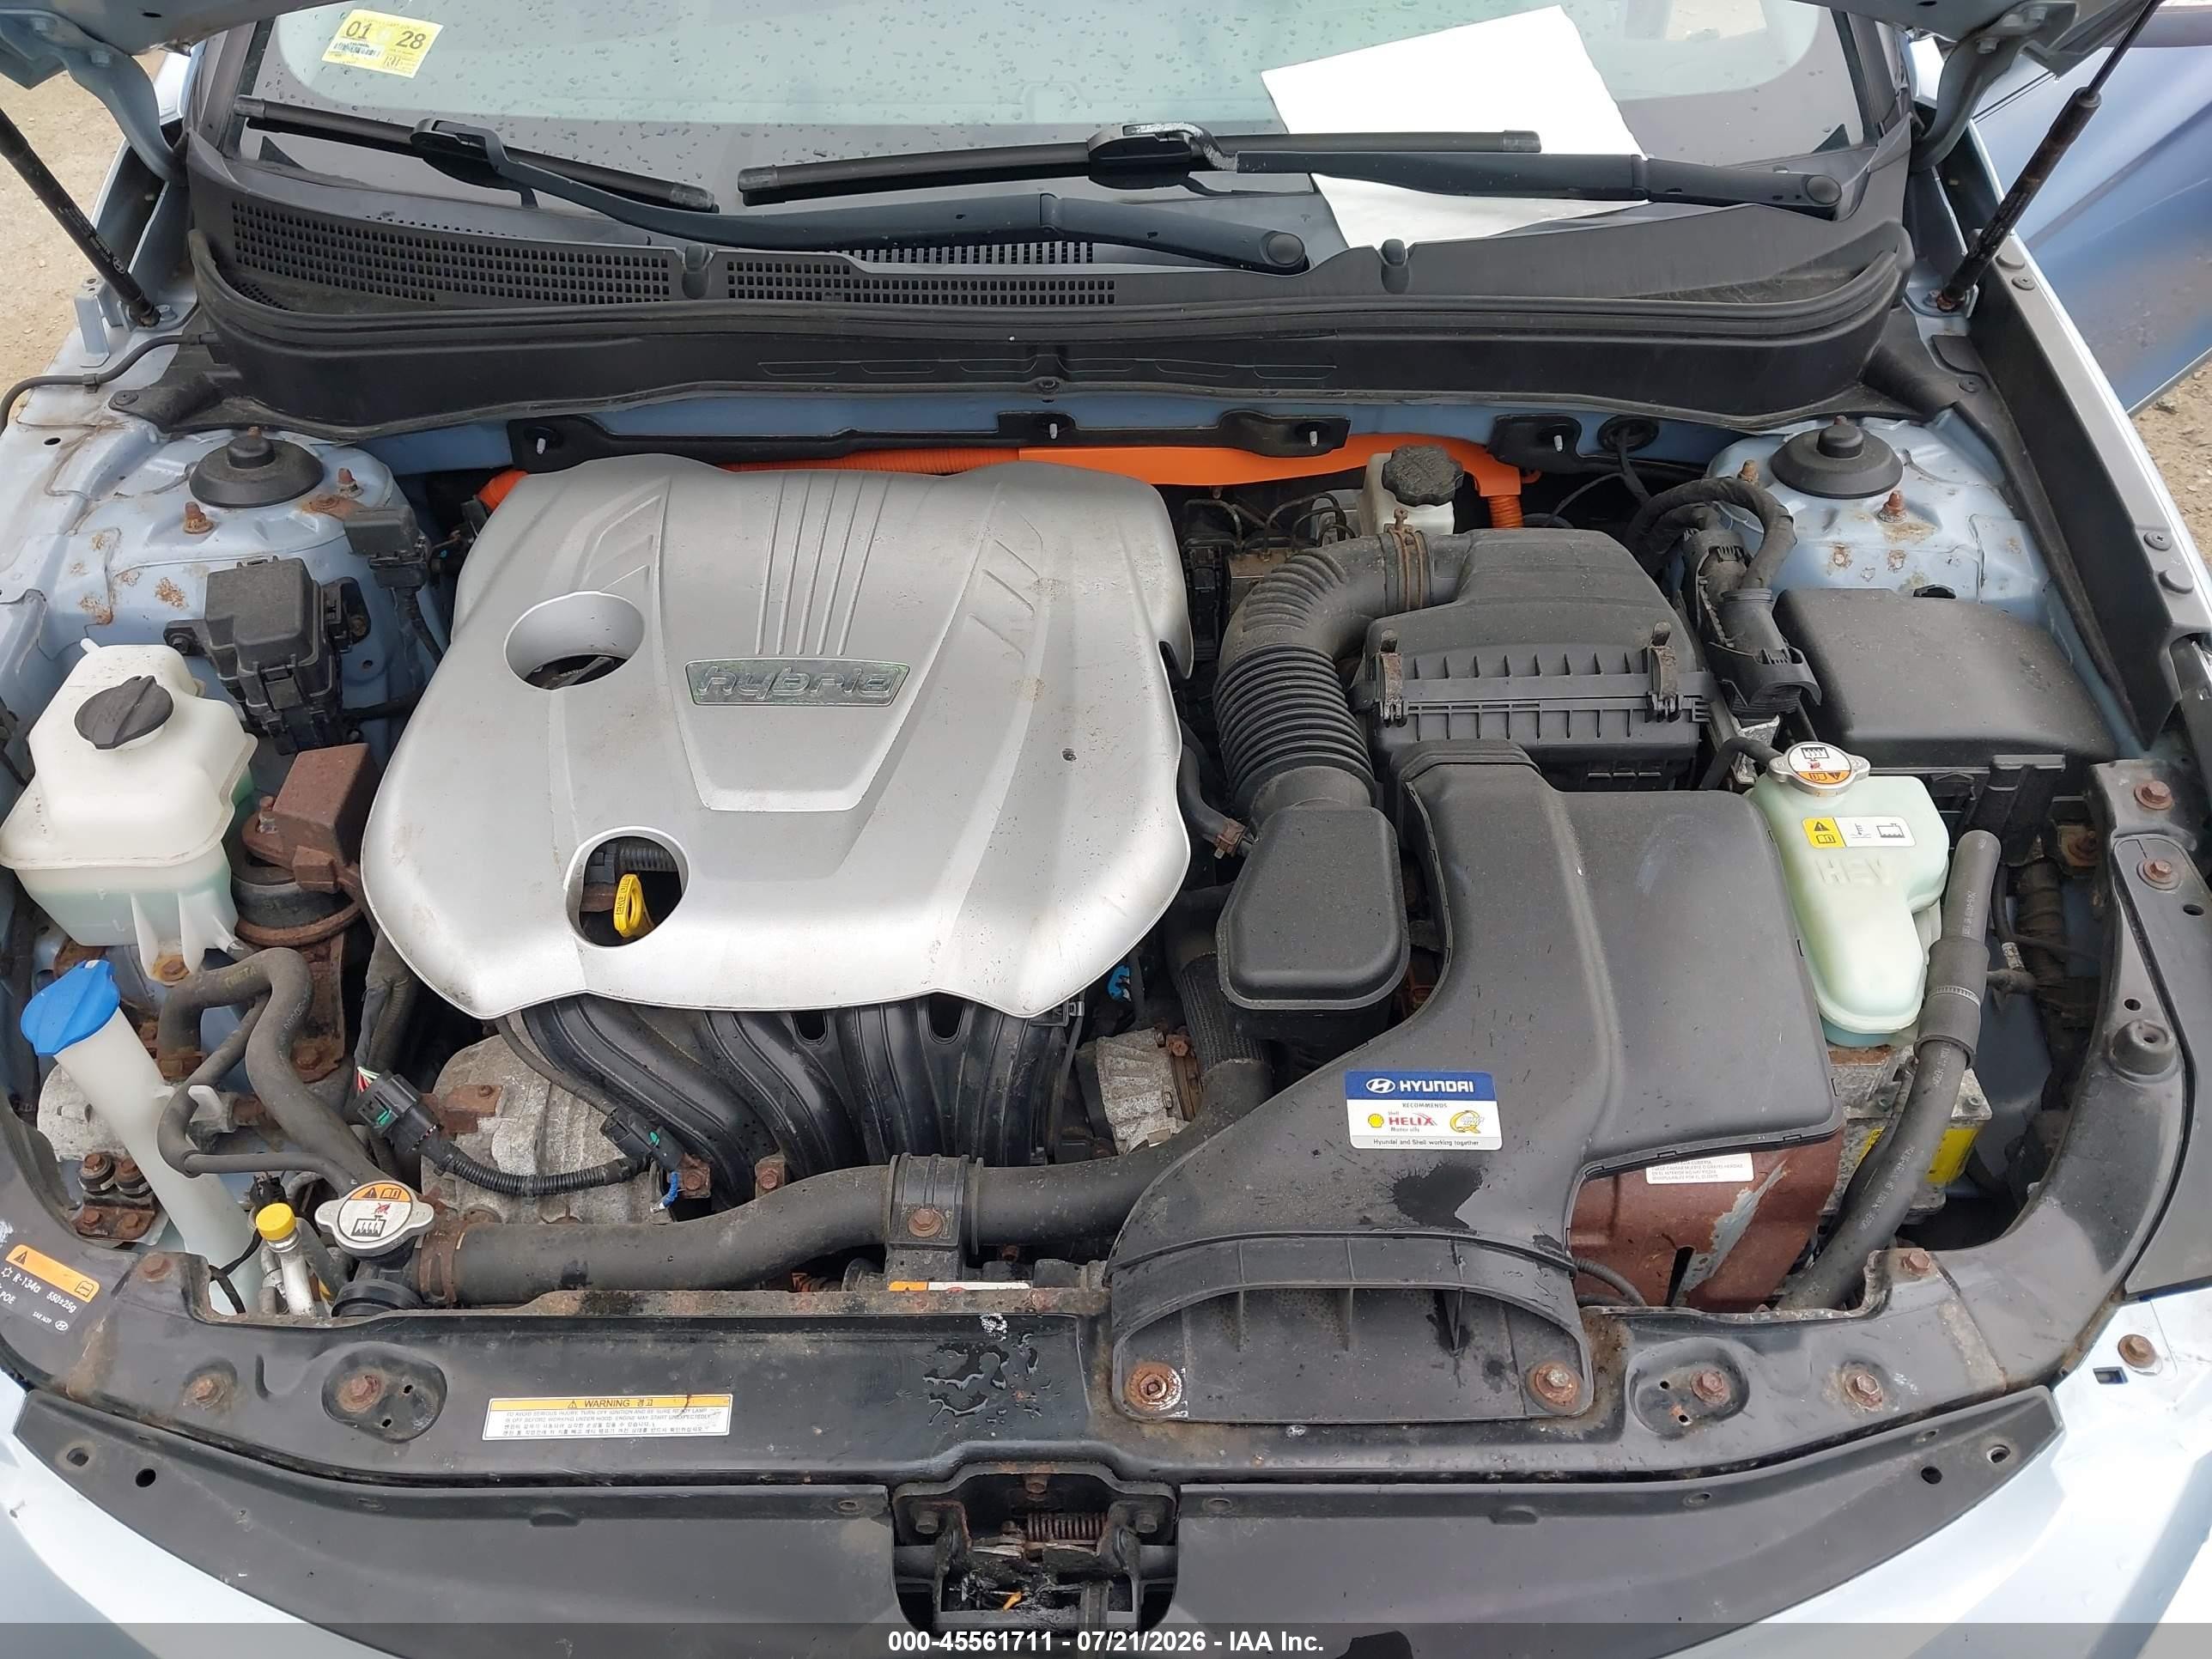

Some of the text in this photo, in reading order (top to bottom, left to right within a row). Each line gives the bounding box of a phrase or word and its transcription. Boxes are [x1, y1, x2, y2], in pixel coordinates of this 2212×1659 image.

[345, 21, 372, 40] 01
[396, 30, 427, 50] 28
[697, 666, 901, 700] hybrid
[1400, 1079, 1474, 1093] HYUNDAI
[1389, 1116, 1435, 1127] HELIX
[0, 1291, 16, 1304] POE
[12, 1273, 77, 1314] R-134a 550±25g
[584, 1398, 653, 1408] WARNING 경고
